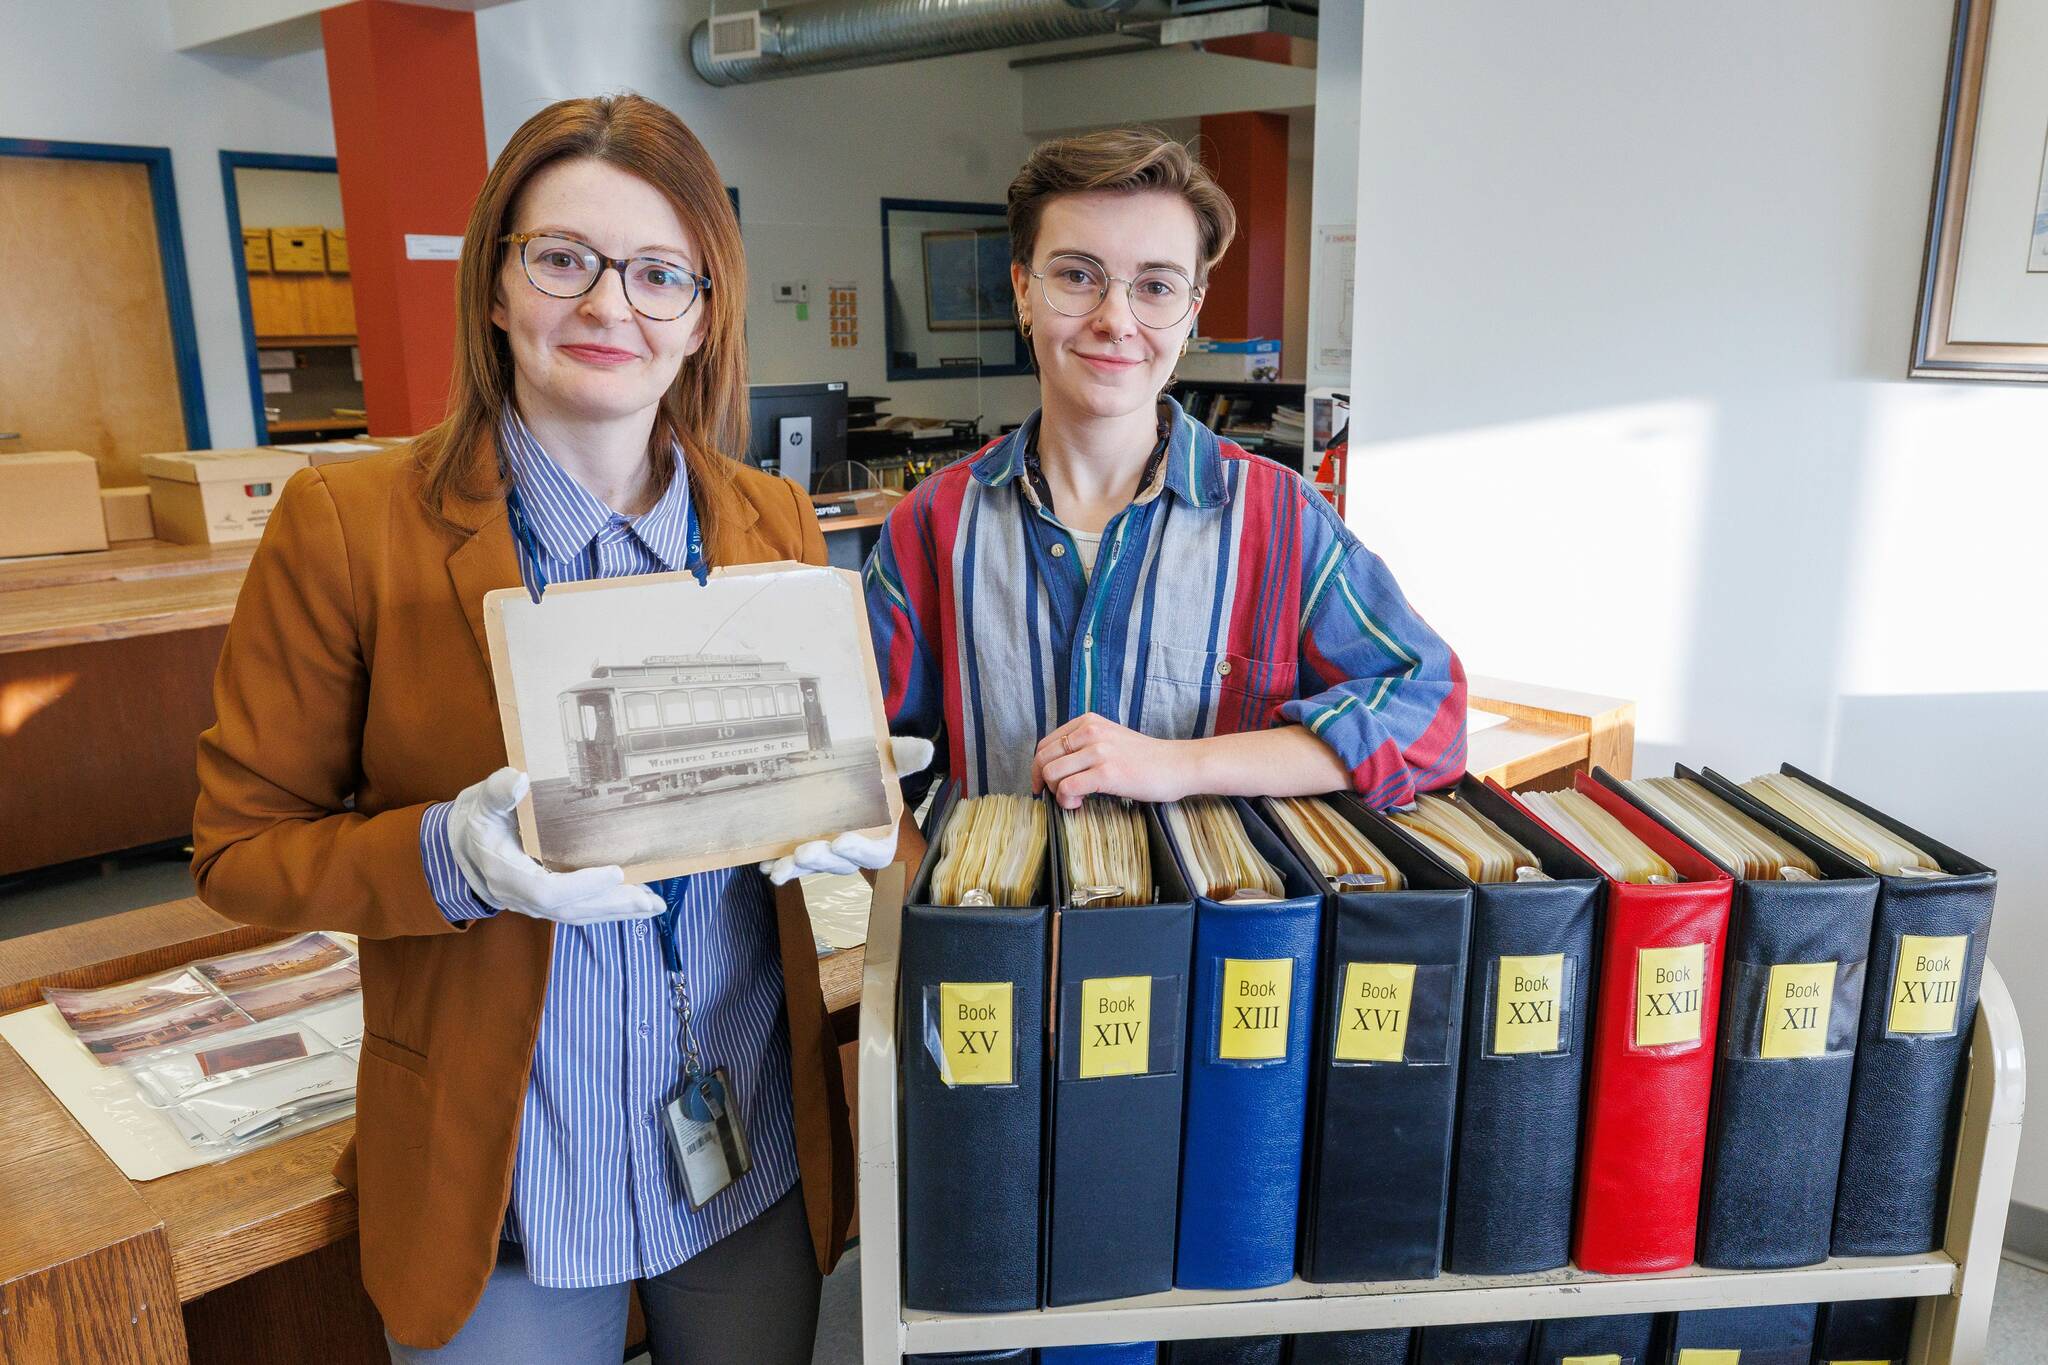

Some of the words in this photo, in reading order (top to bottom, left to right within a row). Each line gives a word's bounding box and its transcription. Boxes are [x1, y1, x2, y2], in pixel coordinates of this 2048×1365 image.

[815, 505, 842, 516] CEPTION
[1913, 953, 1951, 973] Book
[1513, 974, 1550, 993] Book
[1655, 965, 1691, 984] Book
[1237, 980, 1277, 1000] Book
[1360, 981, 1398, 1002] Book
[1784, 981, 1821, 1000] Book
[1901, 979, 1959, 1004] XVIII
[956, 1002, 997, 1022] Book
[1098, 994, 1136, 1015] Book
[1645, 988, 1699, 1016] XXII
[1231, 1004, 1281, 1032] XIII
[1350, 1006, 1401, 1035] XVI
[1506, 1000, 1553, 1026] XXI
[1780, 1006, 1818, 1031] XII
[956, 1029, 1000, 1056] XV
[1091, 1020, 1143, 1050] XIV
